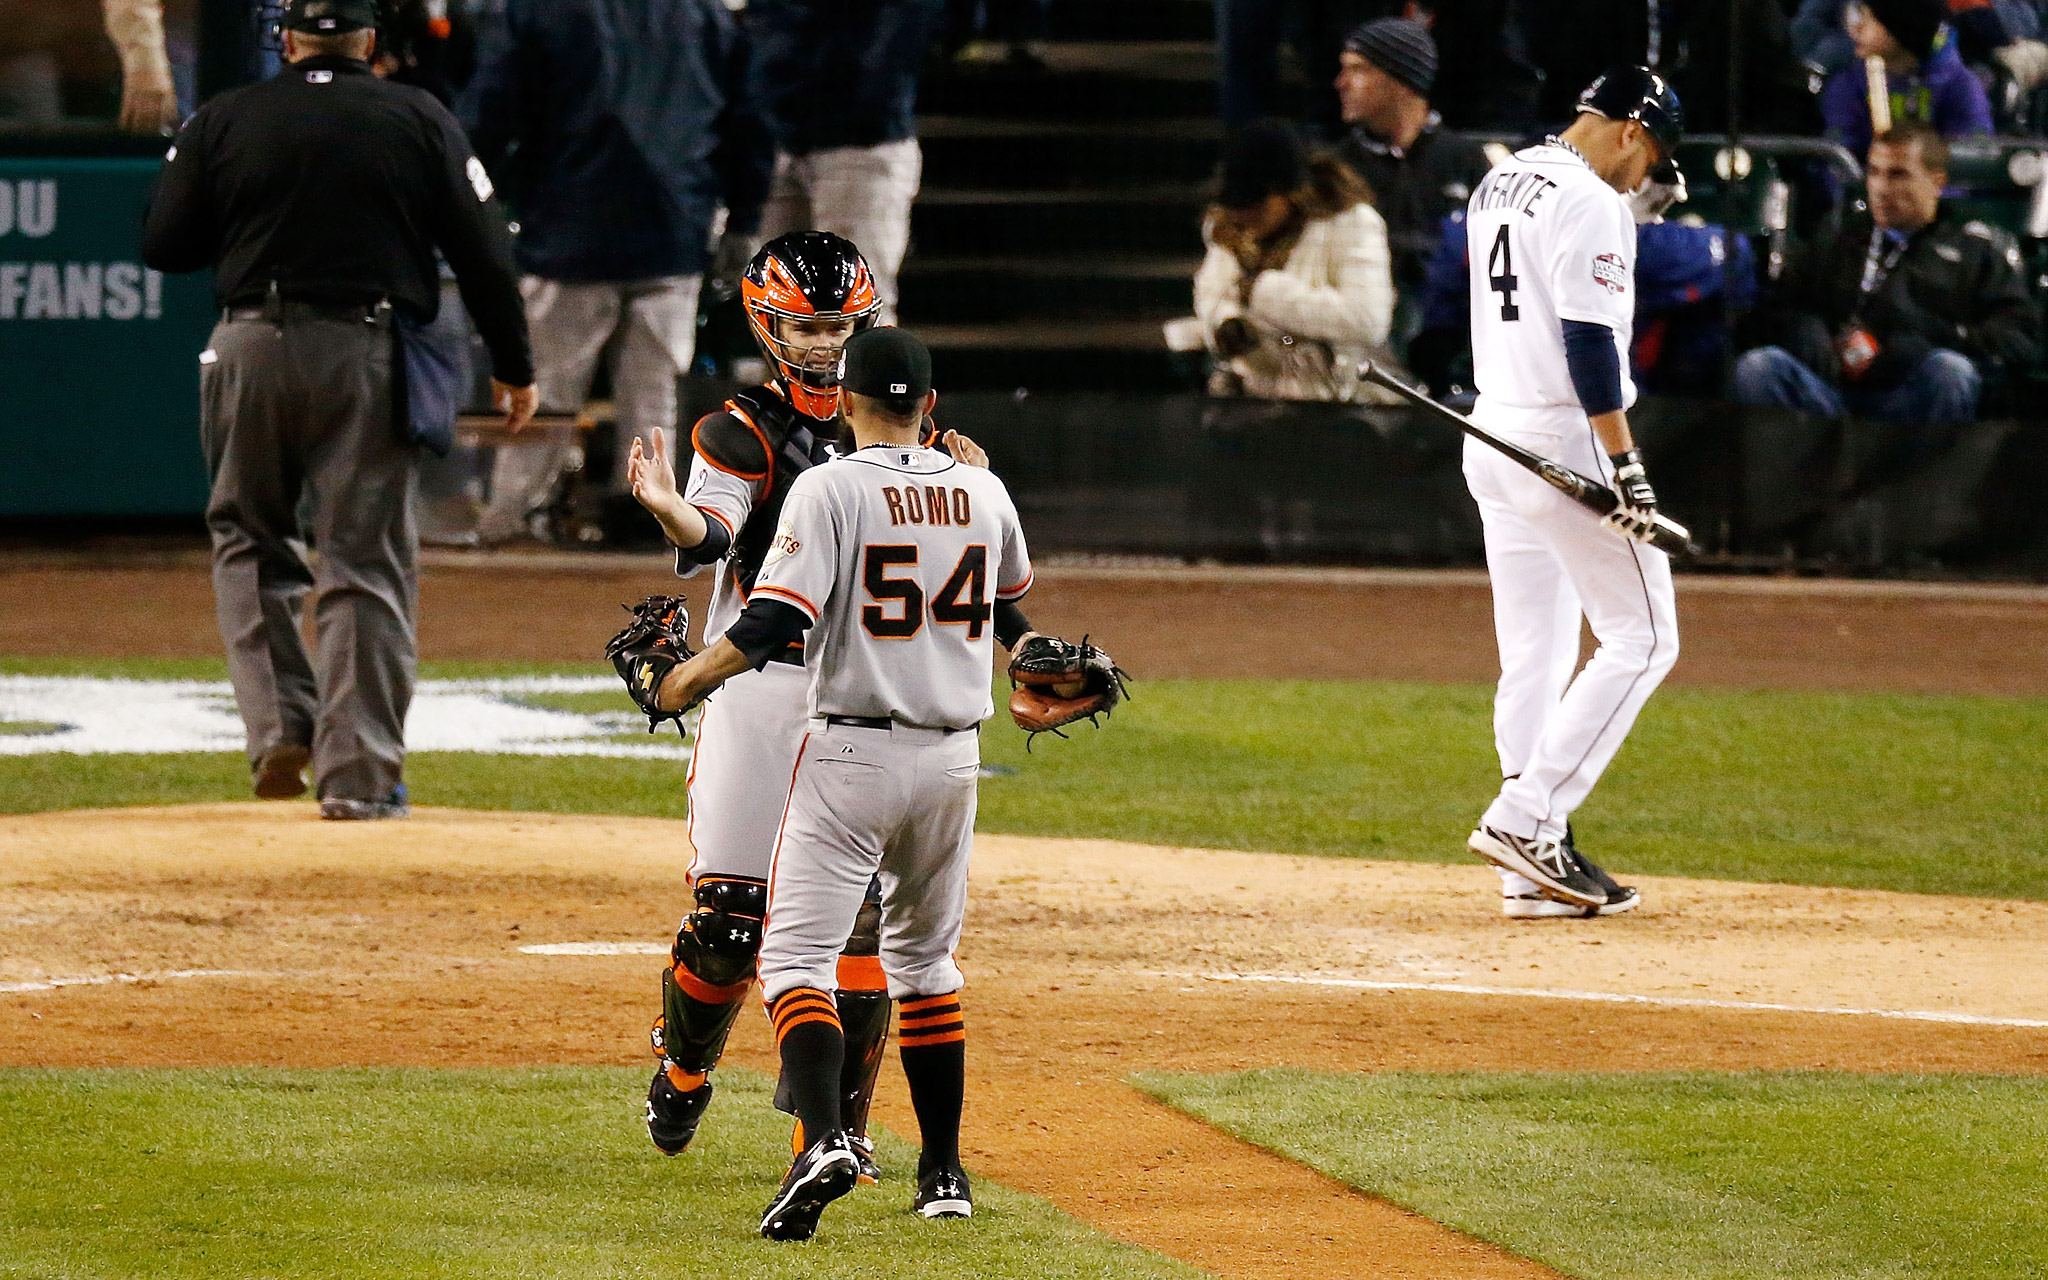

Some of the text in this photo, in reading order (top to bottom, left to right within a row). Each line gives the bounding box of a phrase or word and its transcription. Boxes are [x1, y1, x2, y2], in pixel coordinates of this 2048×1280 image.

[0, 261, 162, 319] FANS!
[1489, 224, 1519, 321] 4
[882, 485, 971, 527] ROMO
[861, 543, 992, 641] 54
